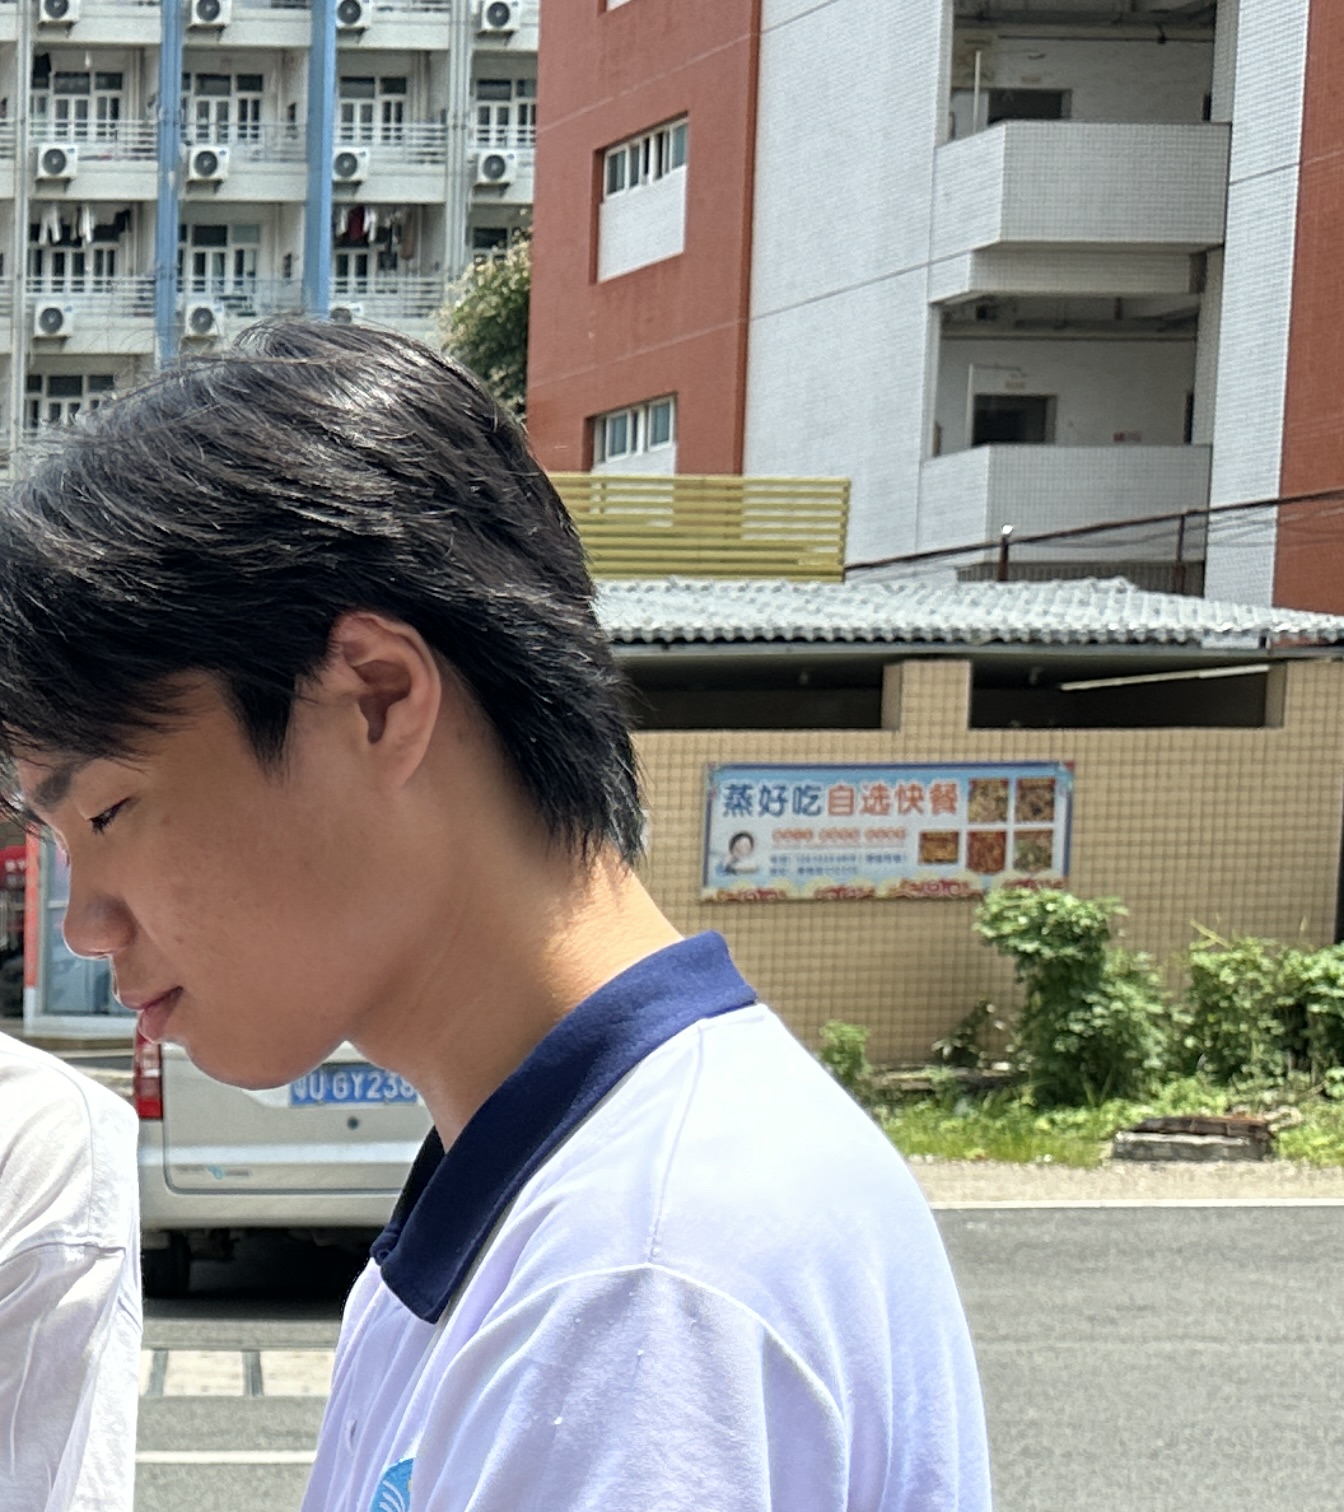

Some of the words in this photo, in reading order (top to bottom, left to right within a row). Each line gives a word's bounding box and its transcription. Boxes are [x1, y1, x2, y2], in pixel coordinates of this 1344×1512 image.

[722, 782, 958, 818] 蒸好吃自选快餐
